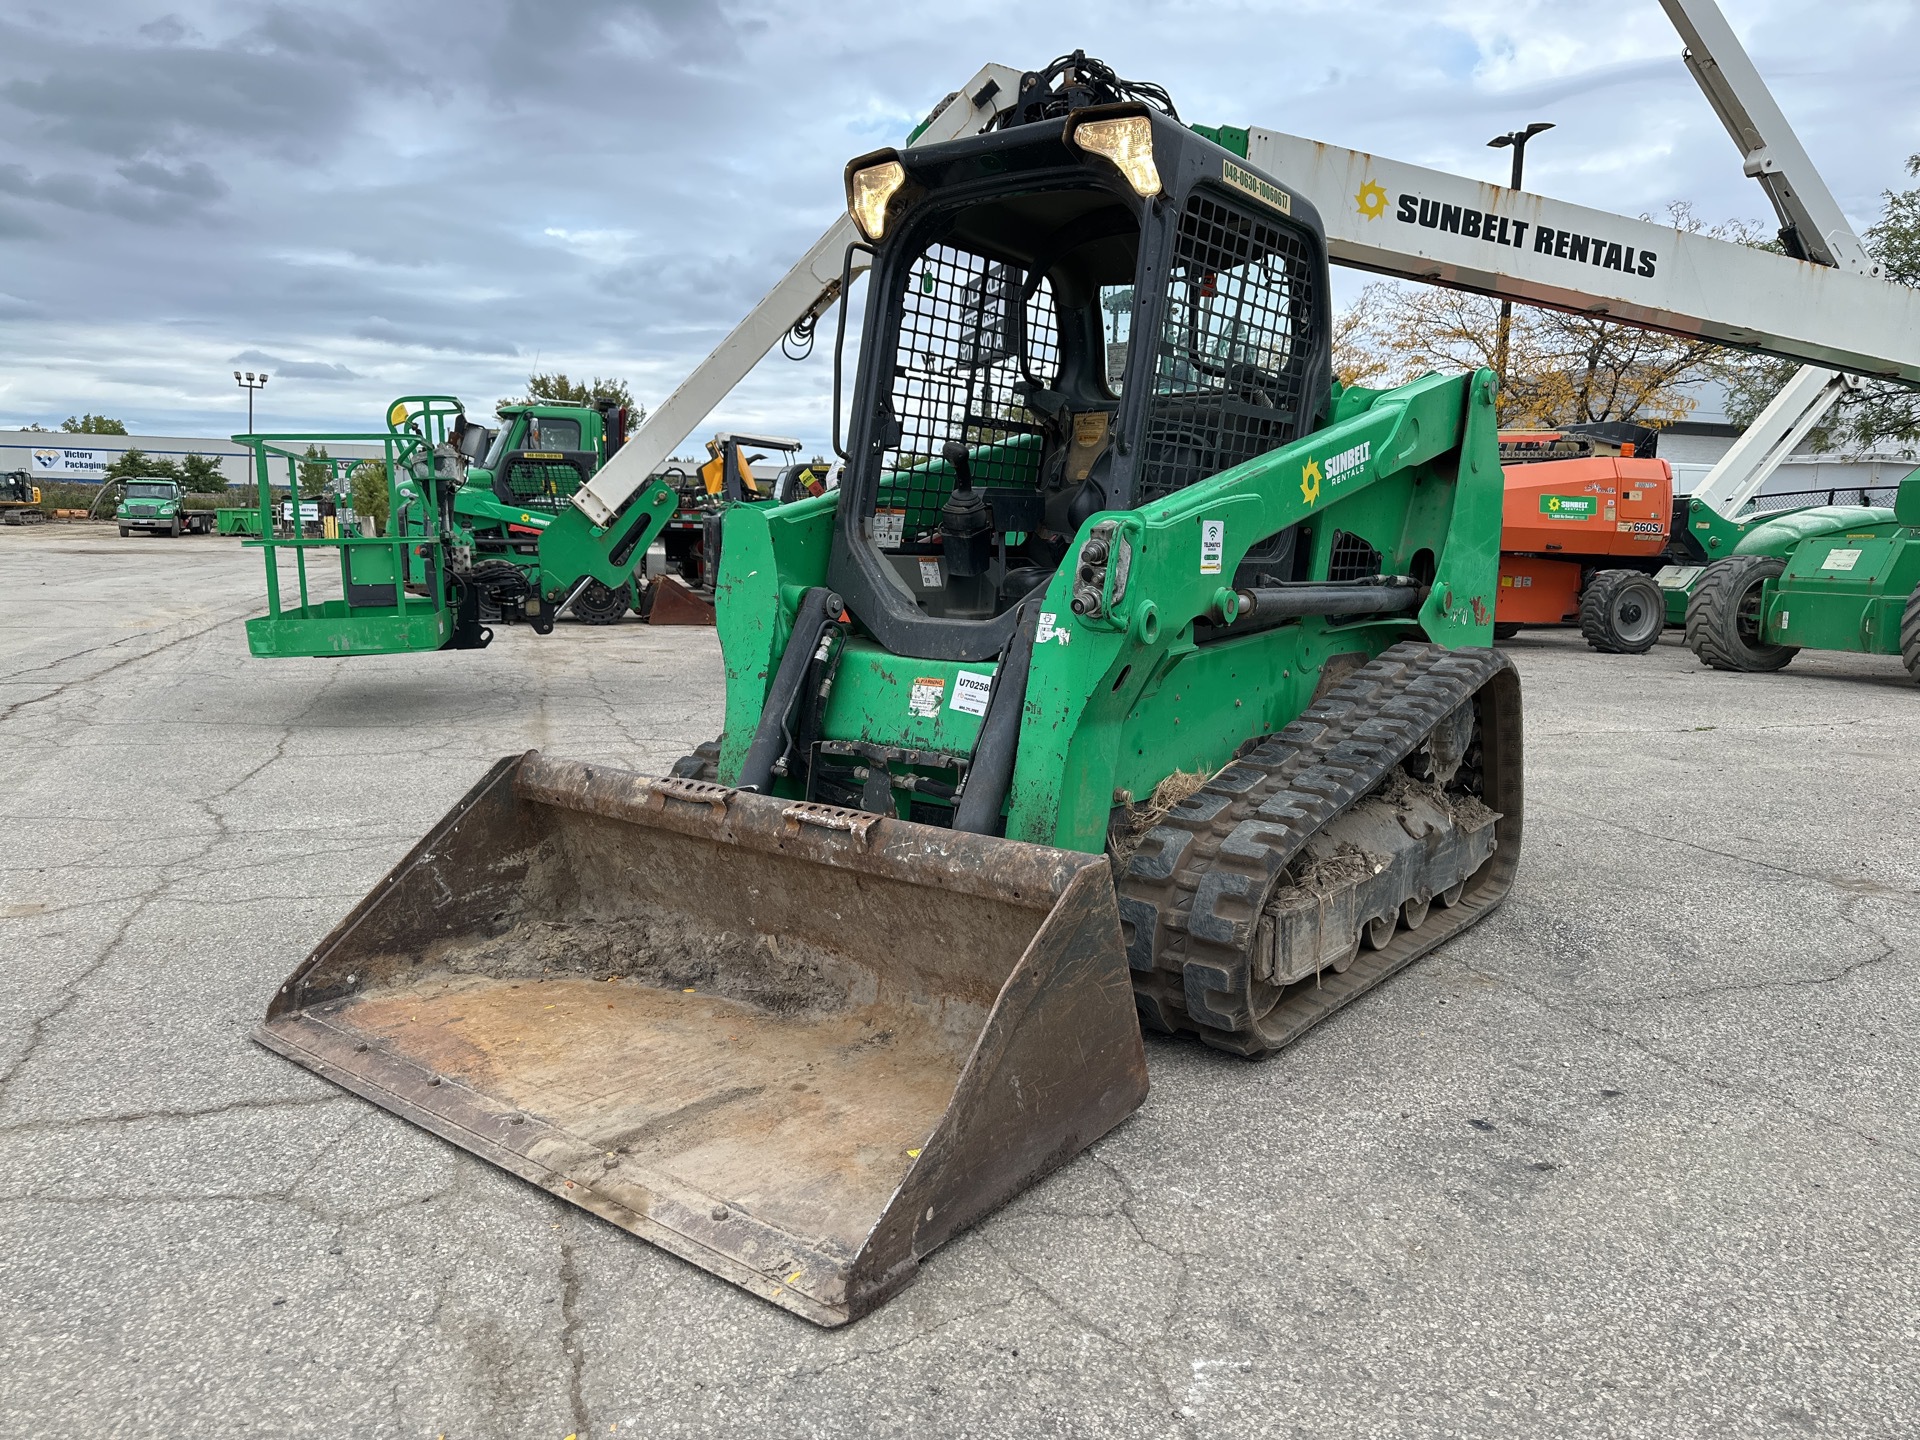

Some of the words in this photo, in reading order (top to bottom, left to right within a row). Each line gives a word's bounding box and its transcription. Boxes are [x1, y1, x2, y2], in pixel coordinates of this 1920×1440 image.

[1396, 193, 1529, 249] SUNBELT
[1533, 225, 1658, 278] RENTALS
[64, 450, 93, 459] Victory
[1324, 441, 1370, 480] SUNBELT
[65, 460, 106, 470] Packaging
[1331, 464, 1365, 487] RENTALS
[1560, 500, 1589, 508] SUNBELT
[1633, 522, 1664, 533] 660SJ
[959, 678, 990, 692] U70258
